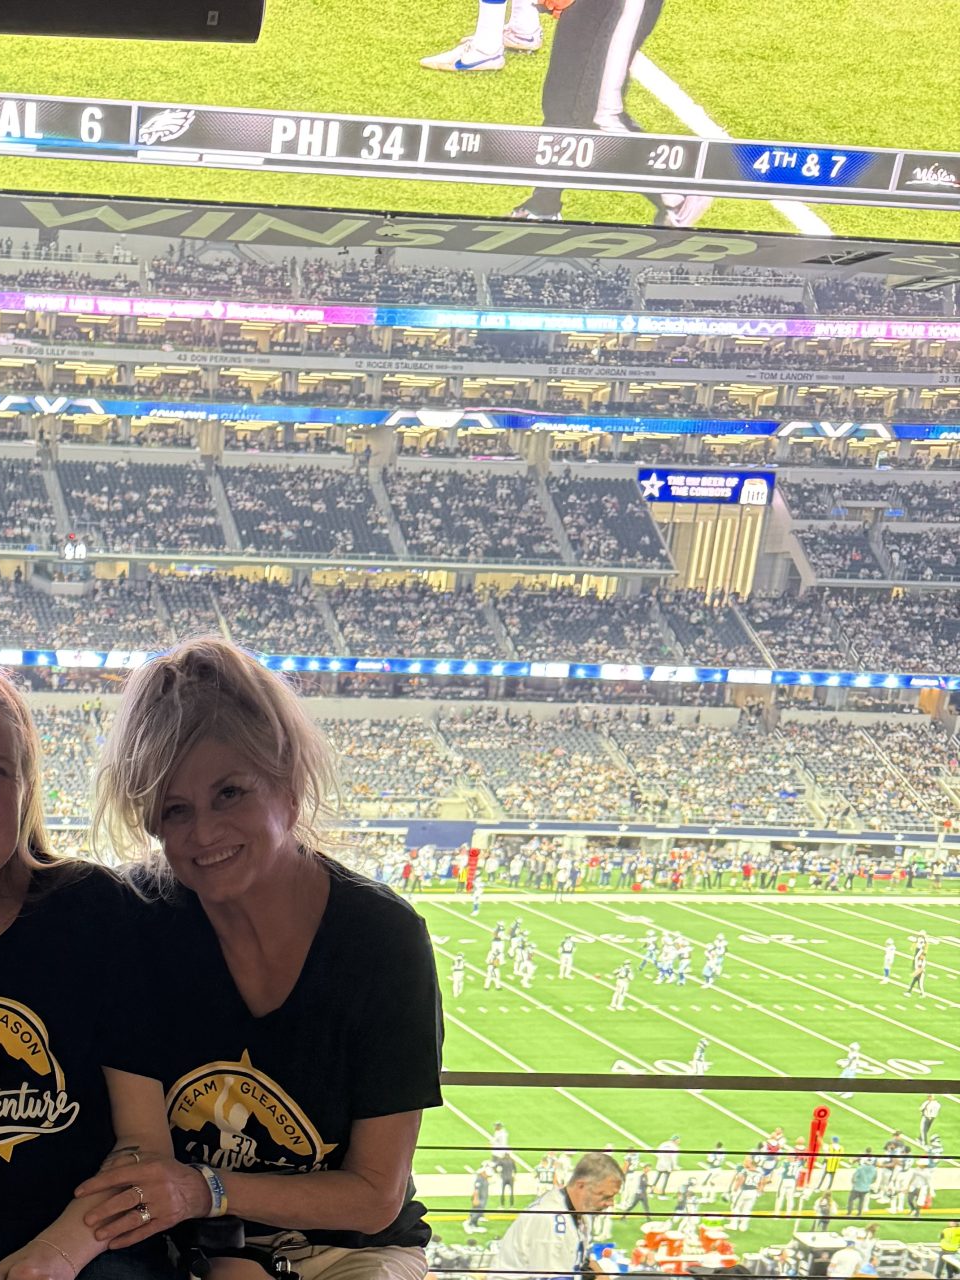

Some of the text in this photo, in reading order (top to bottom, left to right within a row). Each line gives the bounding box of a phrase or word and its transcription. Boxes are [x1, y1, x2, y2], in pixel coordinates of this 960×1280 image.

[79, 107, 103, 144] 6
[271, 117, 405, 162] PHI 34
[443, 130, 684, 171] 4TH 5:20 :20
[752, 149, 847, 180] 4TH & 7
[20, 200, 758, 263] WINSTAR
[209, 354, 242, 364] PERKINS
[366, 361, 393, 370] ROGER
[394, 361, 435, 371] STAUBACH
[561, 368, 577, 376] LEE
[578, 368, 594, 376] ROY
[594, 368, 628, 377] JORDAN
[759, 372, 778, 381] TOM
[779, 372, 814, 382] LANDRY
[667, 475, 685, 486] THE
[671, 486, 732, 498] THE COWBOYS
[177, 1080, 218, 1115] TEAM
[240, 1081, 305, 1147] GLEASON
